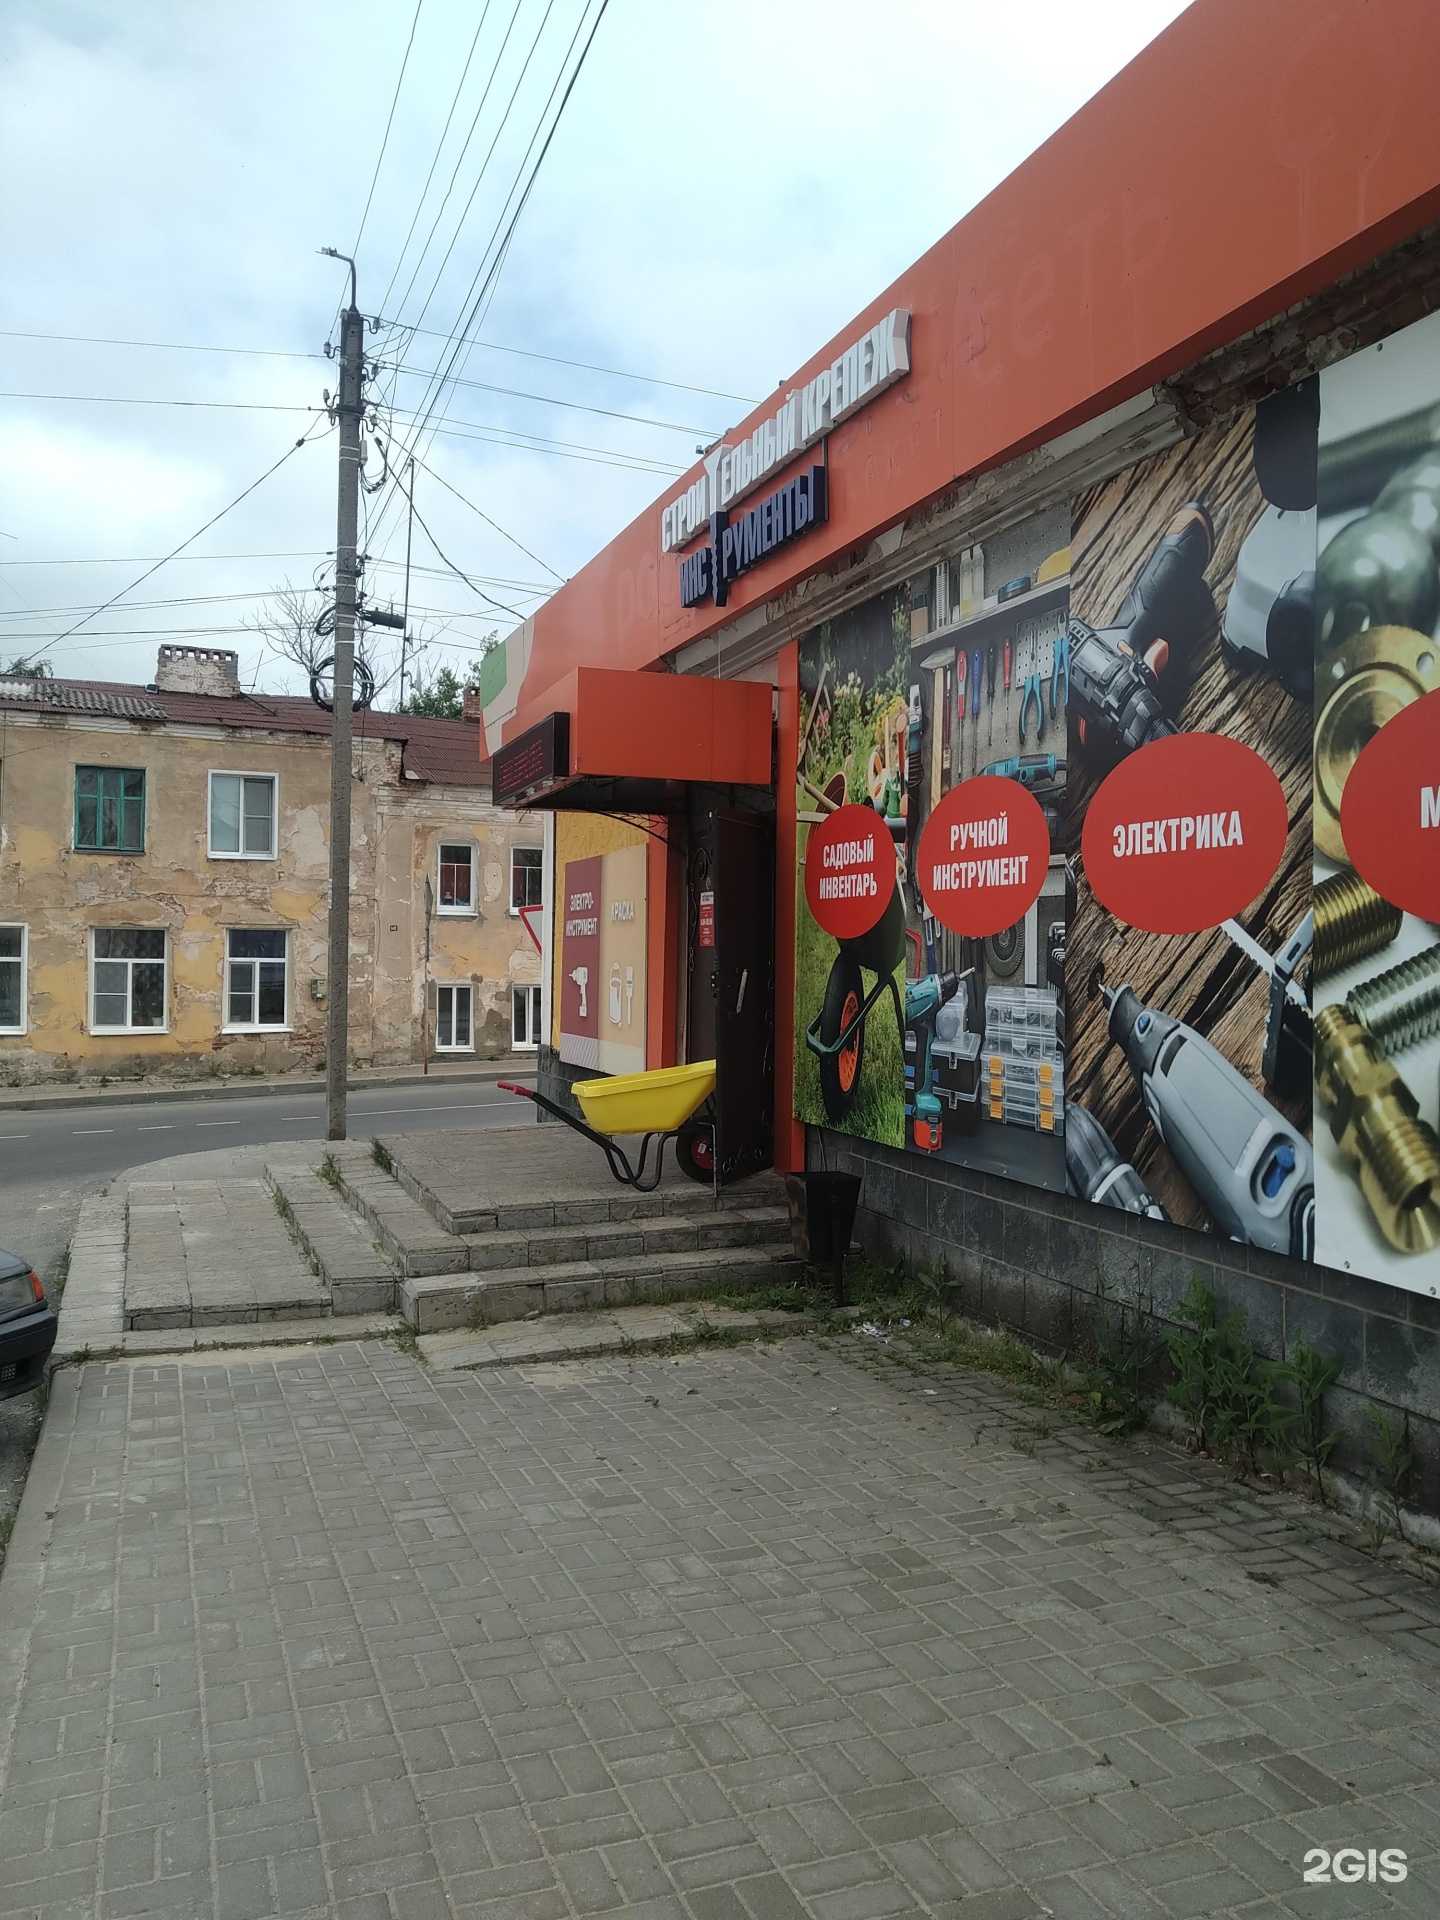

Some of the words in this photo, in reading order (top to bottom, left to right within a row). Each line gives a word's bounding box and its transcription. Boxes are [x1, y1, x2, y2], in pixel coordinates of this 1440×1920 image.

[801, 308, 912, 446] КРЕПЕЖ
[949, 810, 1009, 852] РУЧНОЙ
[1112, 809, 1244, 858] ЭЛЕКТРИКА
[822, 833, 875, 870] САДОВЫЙ
[818, 872, 878, 900] ИНВЕНТАРЬ
[932, 855, 1030, 892] ИНСТРУМЕНТ
[565, 917, 598, 937] ИНСТРУМЕНТ
